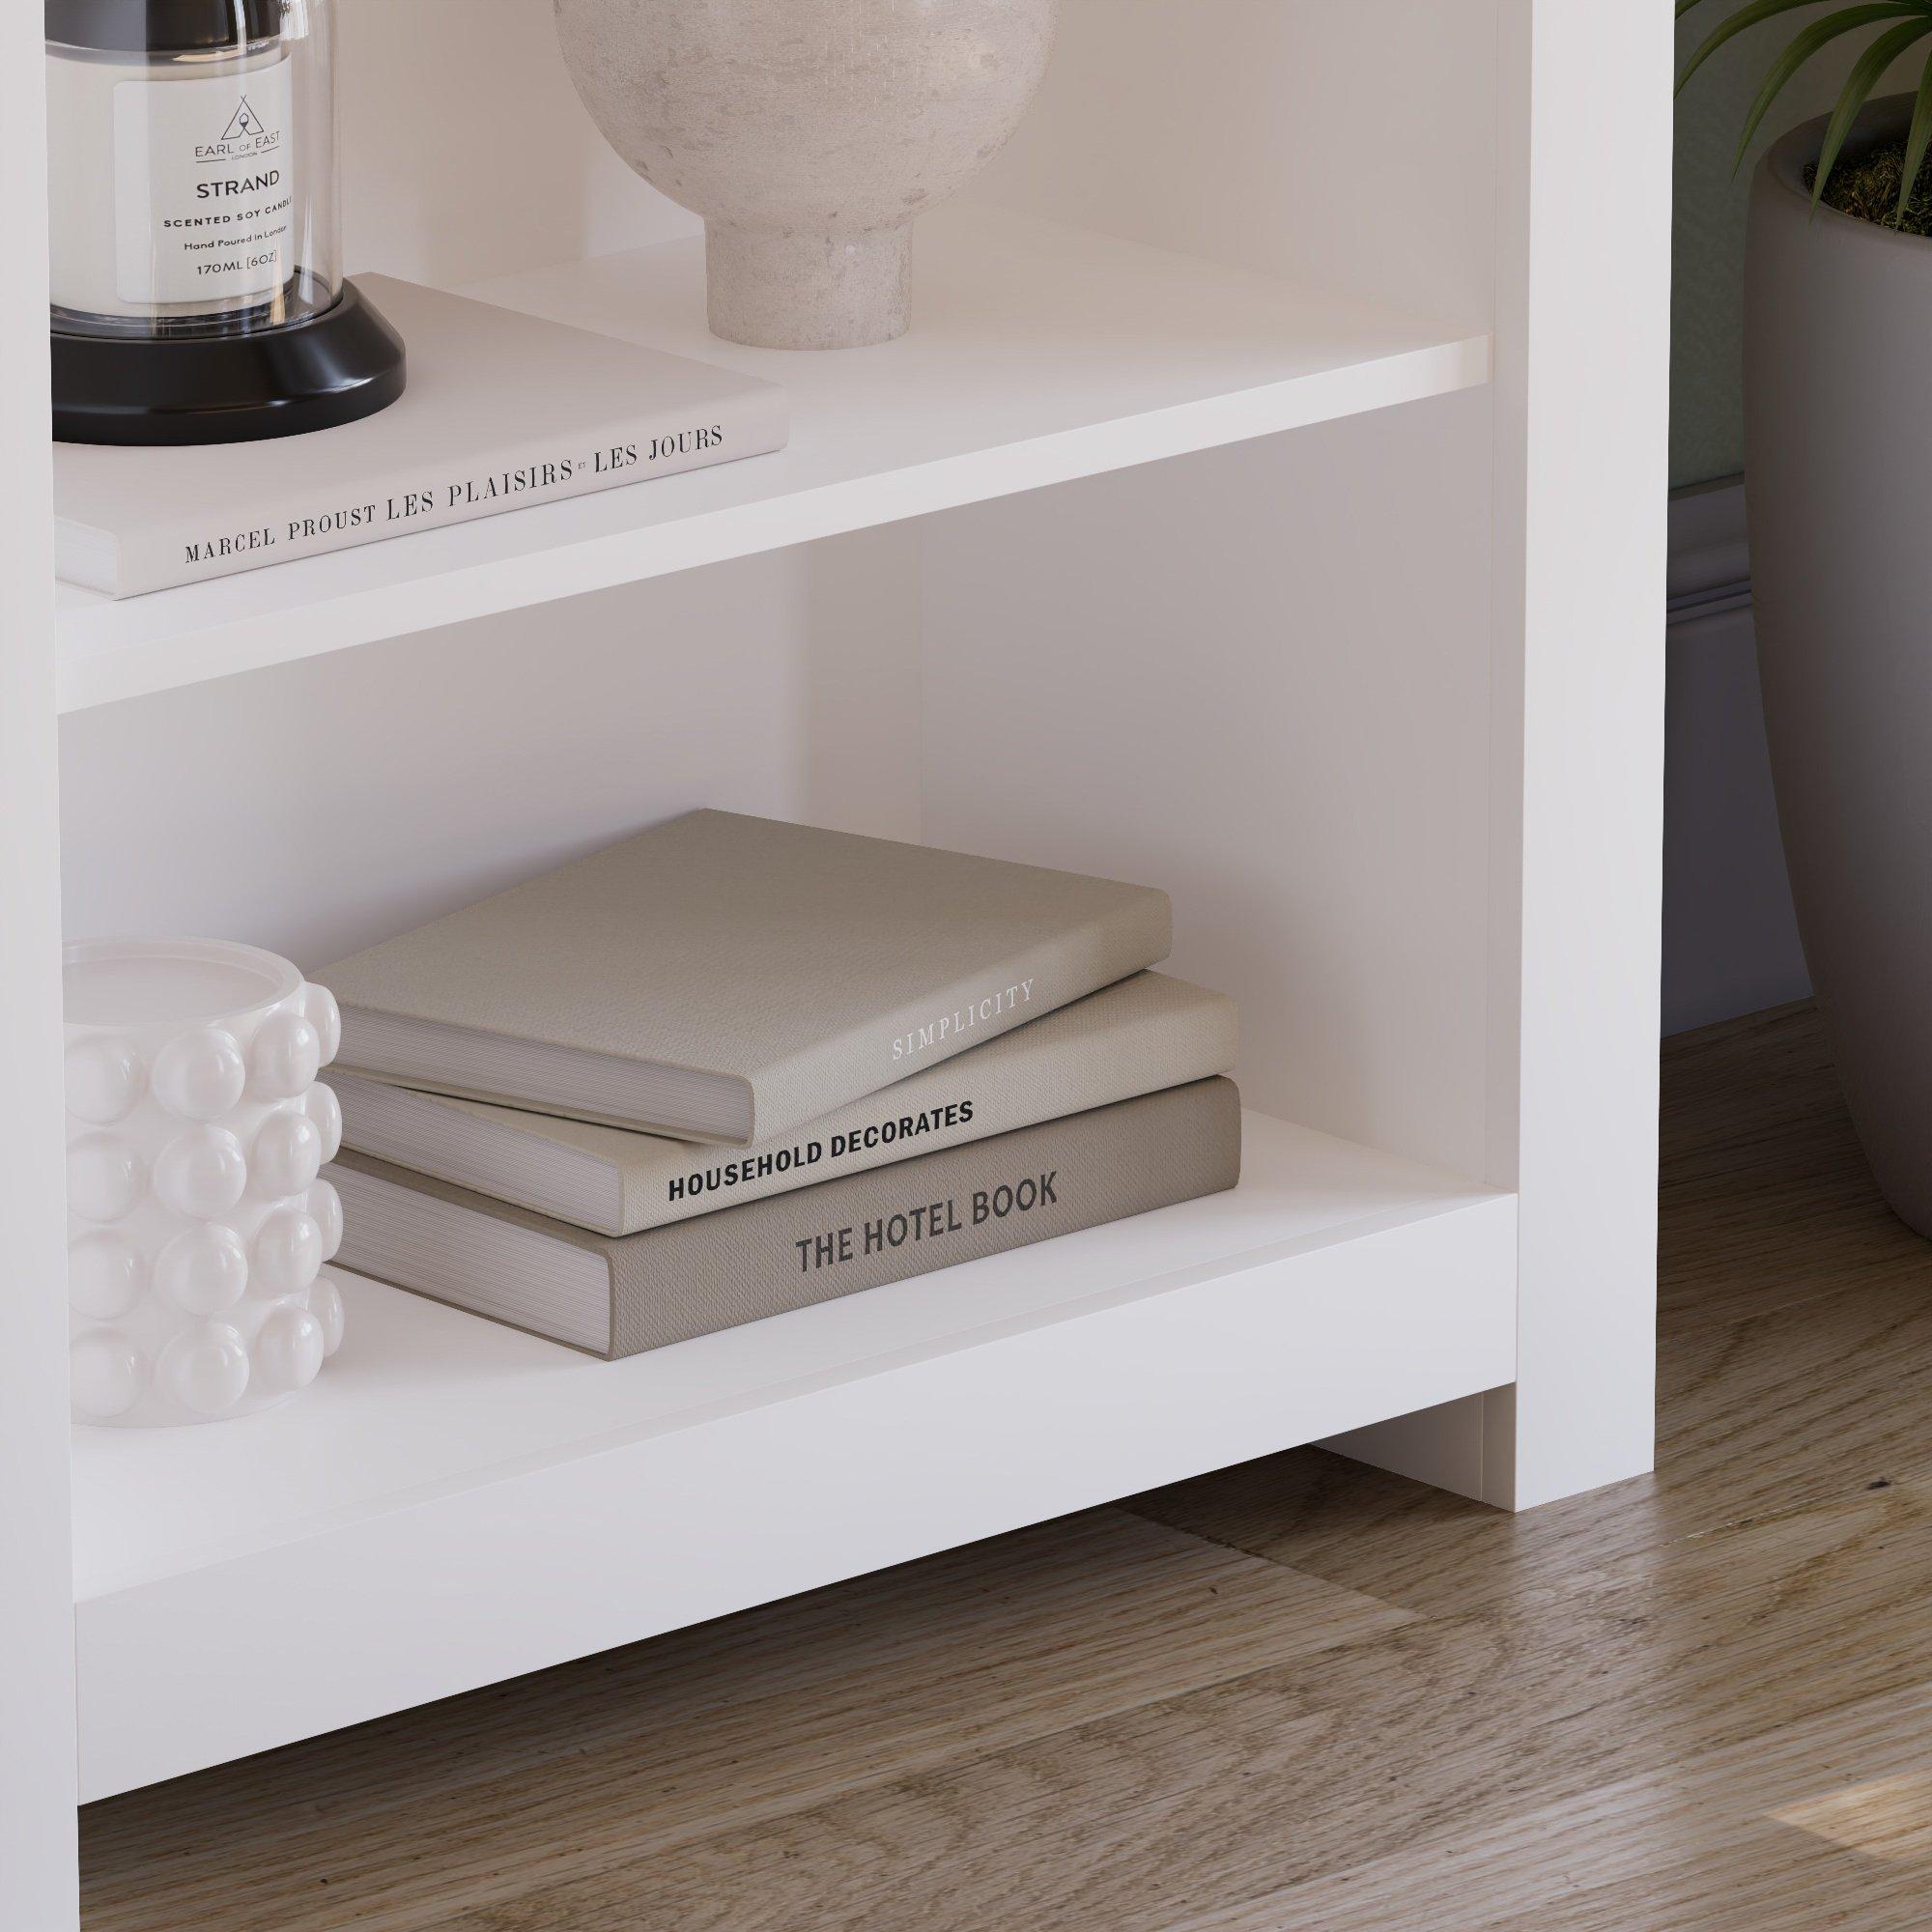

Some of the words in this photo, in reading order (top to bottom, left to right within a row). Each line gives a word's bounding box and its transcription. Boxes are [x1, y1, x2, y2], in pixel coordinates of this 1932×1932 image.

[195, 144, 235, 157] EARL
[239, 143, 251, 152] OF
[255, 130, 280, 149] EAST
[196, 170, 280, 198] STRAND
[163, 215, 231, 228] SCENTED
[237, 209, 261, 221] SOY
[185, 241, 214, 250] Hand
[217, 235, 252, 247] Poured
[196, 261, 243, 275] 170ML
[185, 527, 275, 564] MARCEL
[288, 504, 376, 541] PROUST
[385, 490, 434, 522] LES
[447, 459, 573, 507] PLAISIRS
[594, 444, 638, 473] LES
[648, 425, 724, 461] JOURS
[892, 978, 1035, 1061] SIMPLICITY
[668, 1142, 822, 1202] HOUSEHOLD
[830, 1100, 975, 1158] DECORATES
[795, 1227, 854, 1273] THE
[864, 1199, 962, 1256] HOTEL
[972, 1171, 1058, 1226] BOOK
